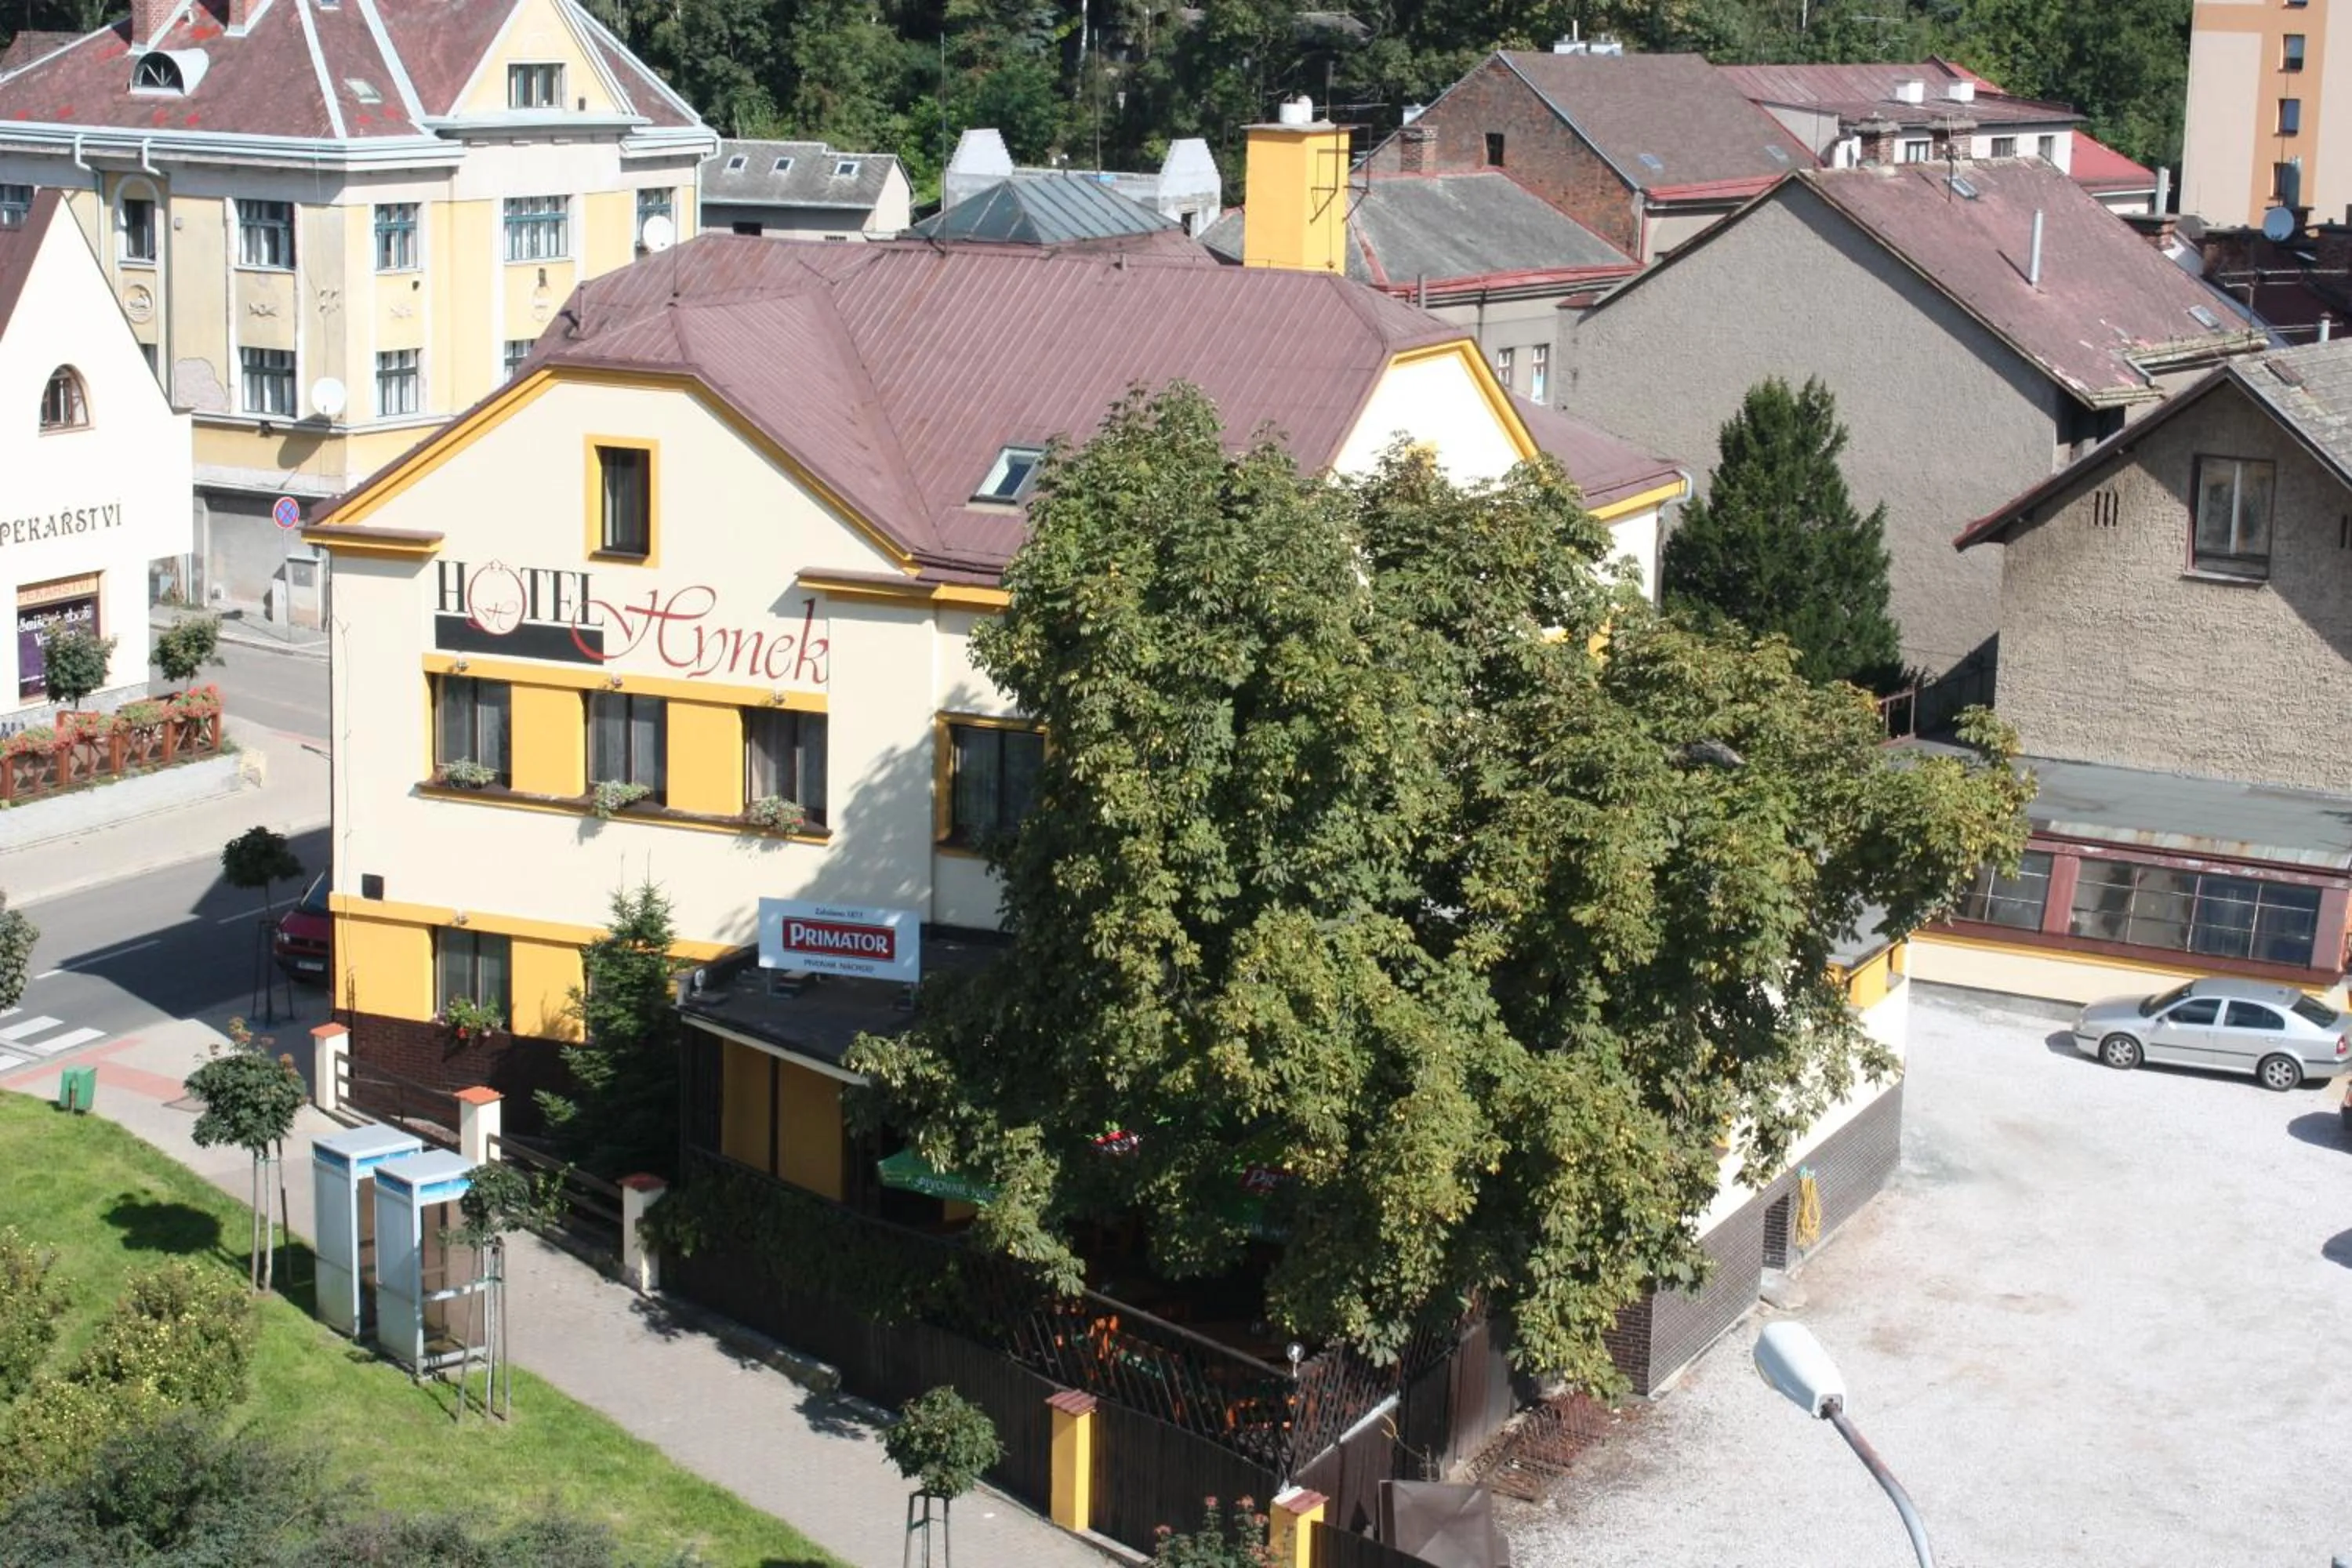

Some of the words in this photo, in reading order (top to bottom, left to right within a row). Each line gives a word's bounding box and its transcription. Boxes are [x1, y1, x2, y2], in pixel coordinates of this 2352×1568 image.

[0, 496, 122, 546] PEKAŘSTVÍ
[434, 559, 604, 634] HOTEL
[571, 585, 829, 684] Hynek
